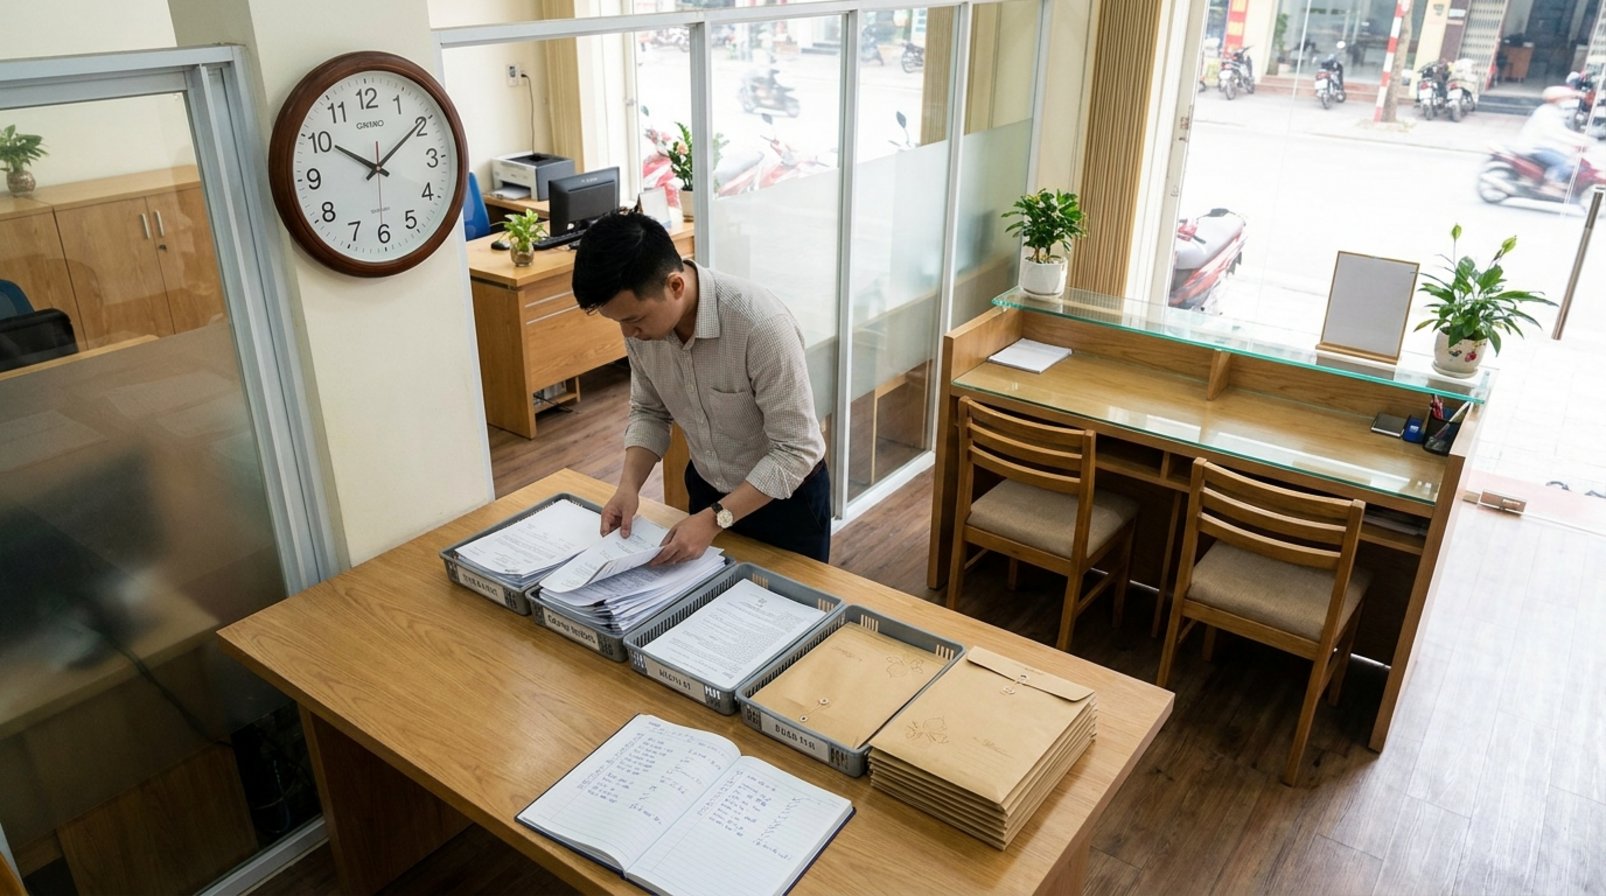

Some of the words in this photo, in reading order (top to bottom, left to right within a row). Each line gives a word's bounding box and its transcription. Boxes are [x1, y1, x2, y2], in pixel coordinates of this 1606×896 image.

[355, 87, 379, 110] 12
[392, 94, 402, 115] 1
[327, 101, 347, 124] 11
[414, 116, 428, 137] 2
[307, 130, 333, 154] 10
[425, 147, 439, 168] 3
[306, 168, 322, 190] 9
[421, 182, 435, 201] 4
[321, 201, 336, 223] 8
[404, 209, 418, 230] 5
[347, 220, 362, 242] 7
[377, 223, 391, 244] 6
